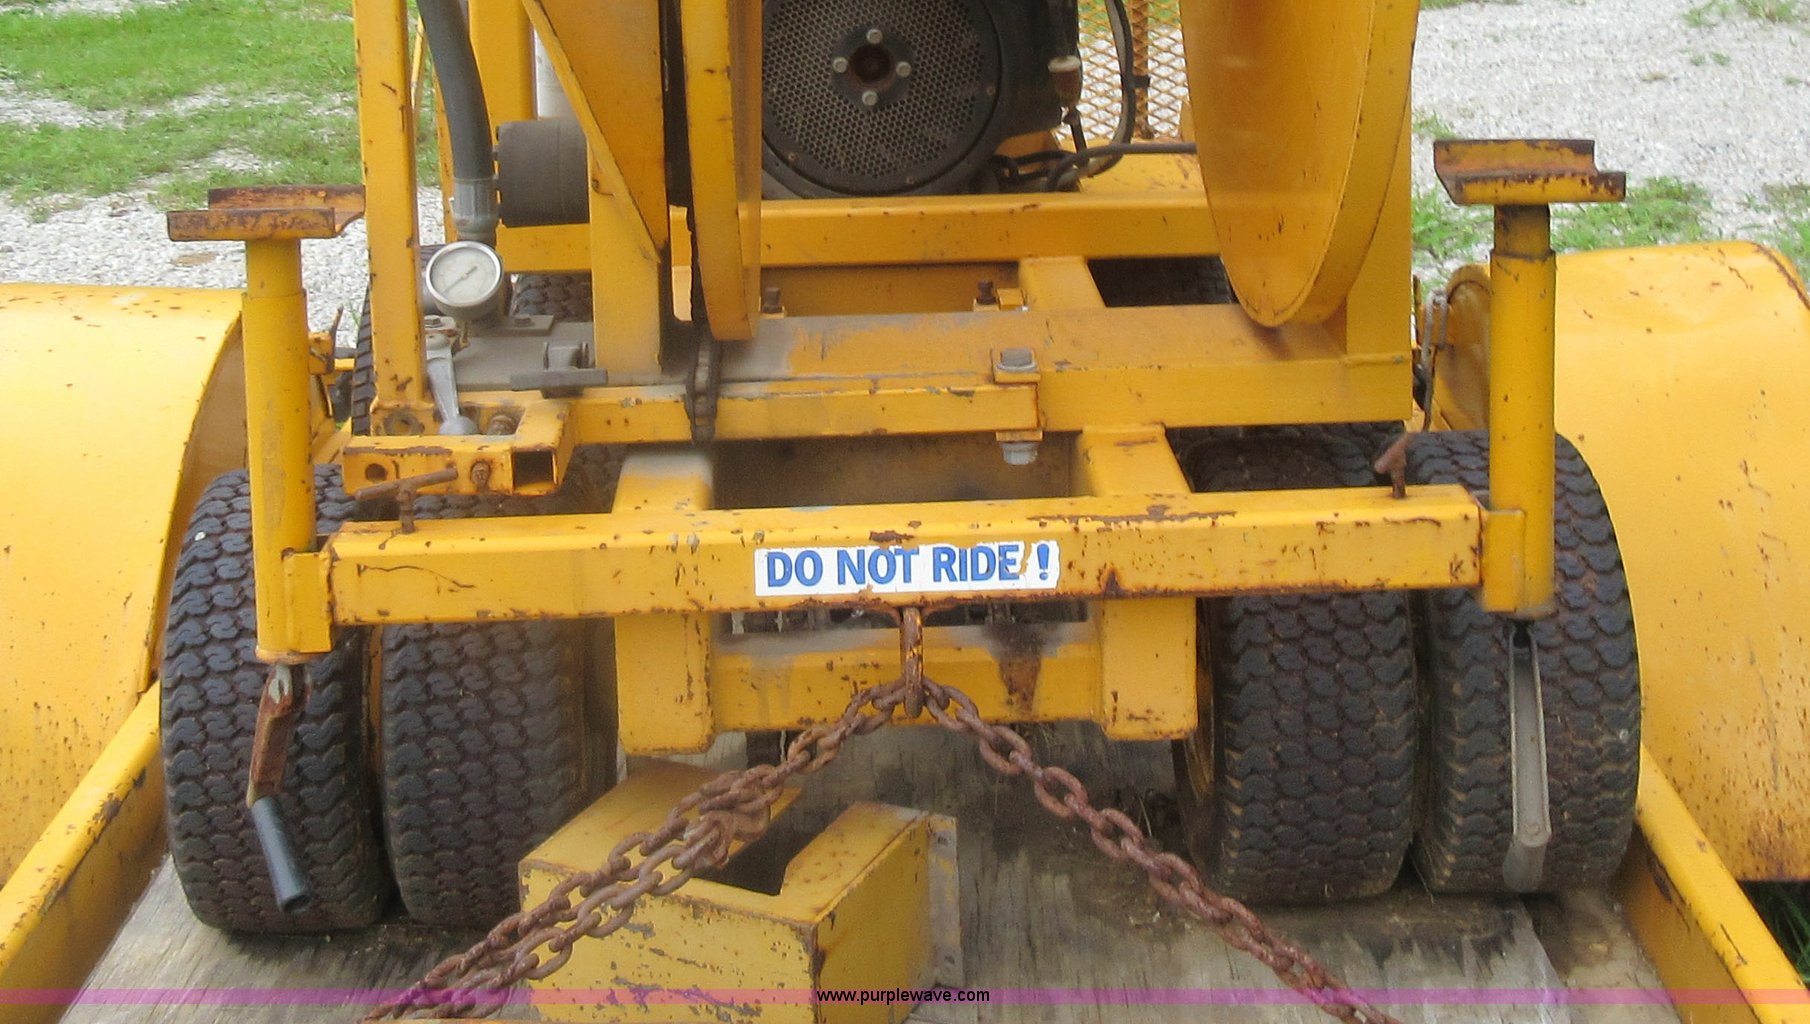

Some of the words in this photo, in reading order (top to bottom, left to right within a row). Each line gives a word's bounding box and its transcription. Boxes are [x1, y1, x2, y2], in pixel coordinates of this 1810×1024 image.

[767, 550, 823, 587] DO
[837, 547, 919, 585] NOT
[933, 544, 1020, 583] RIDE
